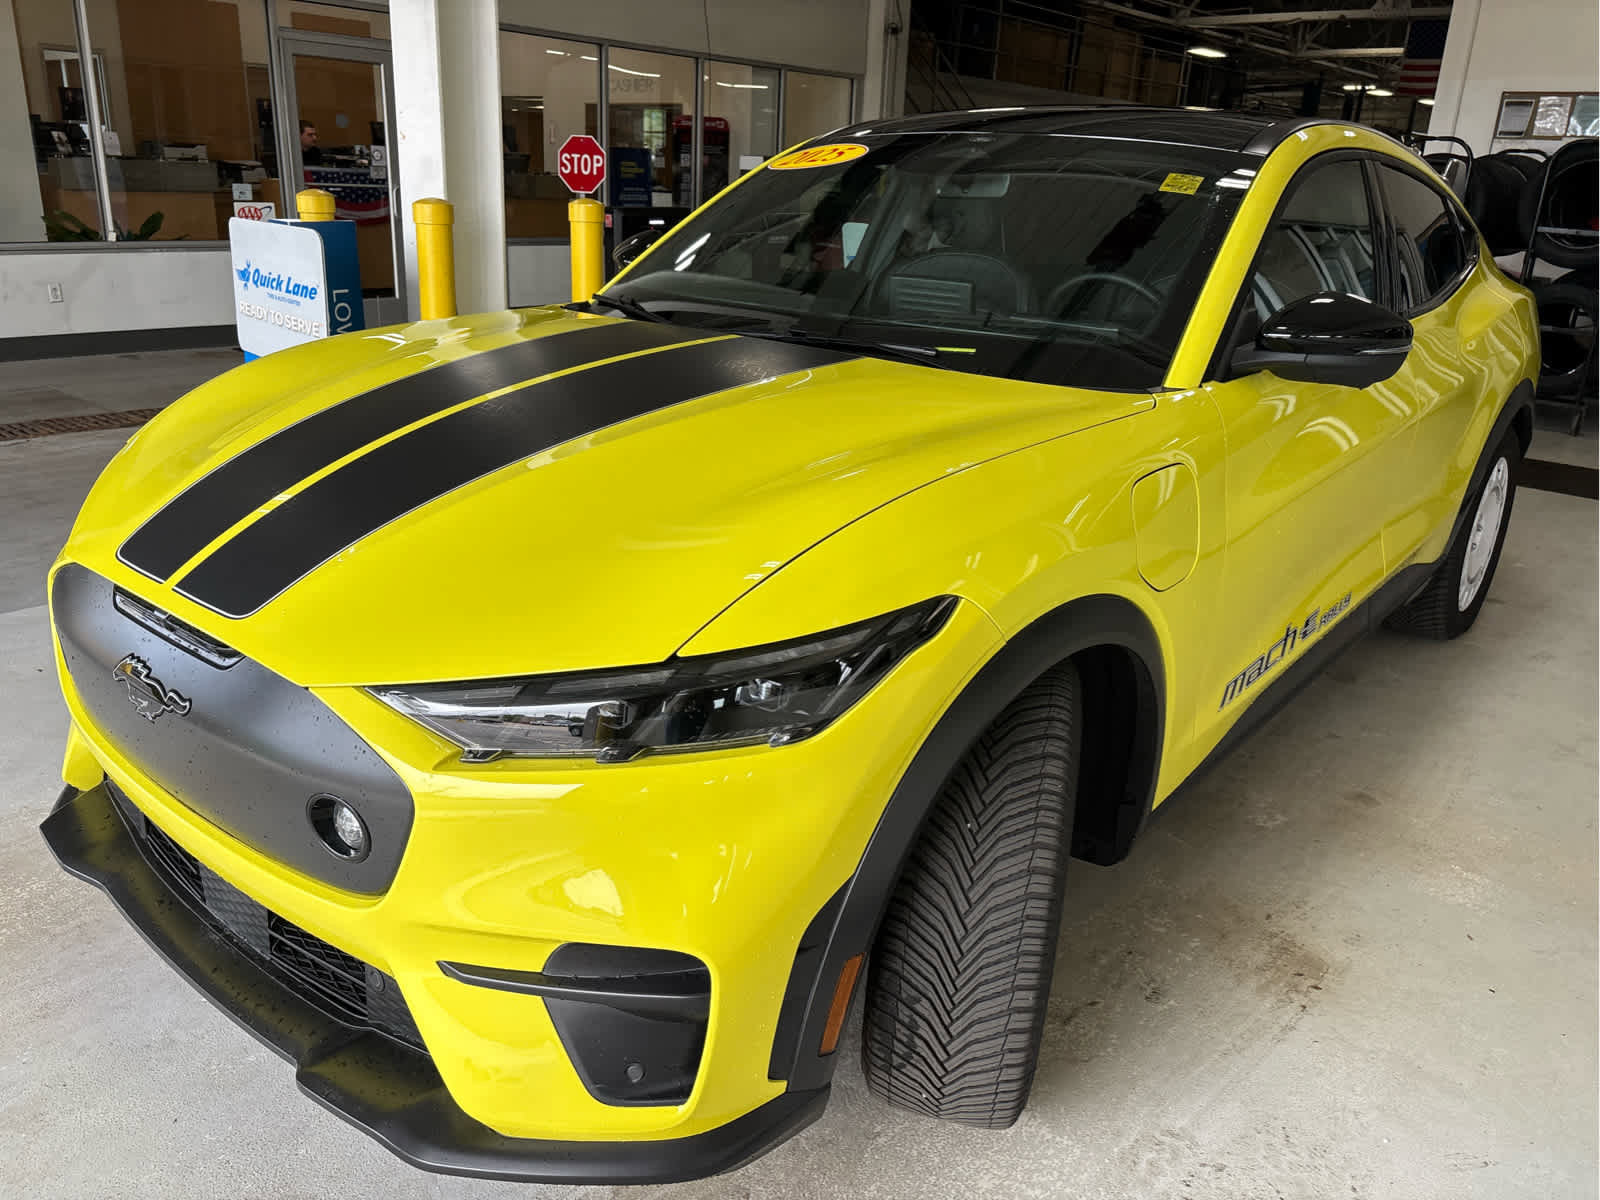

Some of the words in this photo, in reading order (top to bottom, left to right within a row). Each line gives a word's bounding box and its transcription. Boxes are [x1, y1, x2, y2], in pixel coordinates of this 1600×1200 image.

[561, 153, 603, 176] STOP
[775, 147, 857, 165] 2025
[252, 268, 284, 292] Quick
[285, 276, 318, 300] Lane
[239, 301, 269, 321] READY
[270, 310, 284, 327] TO
[284, 314, 320, 338] SERVE
